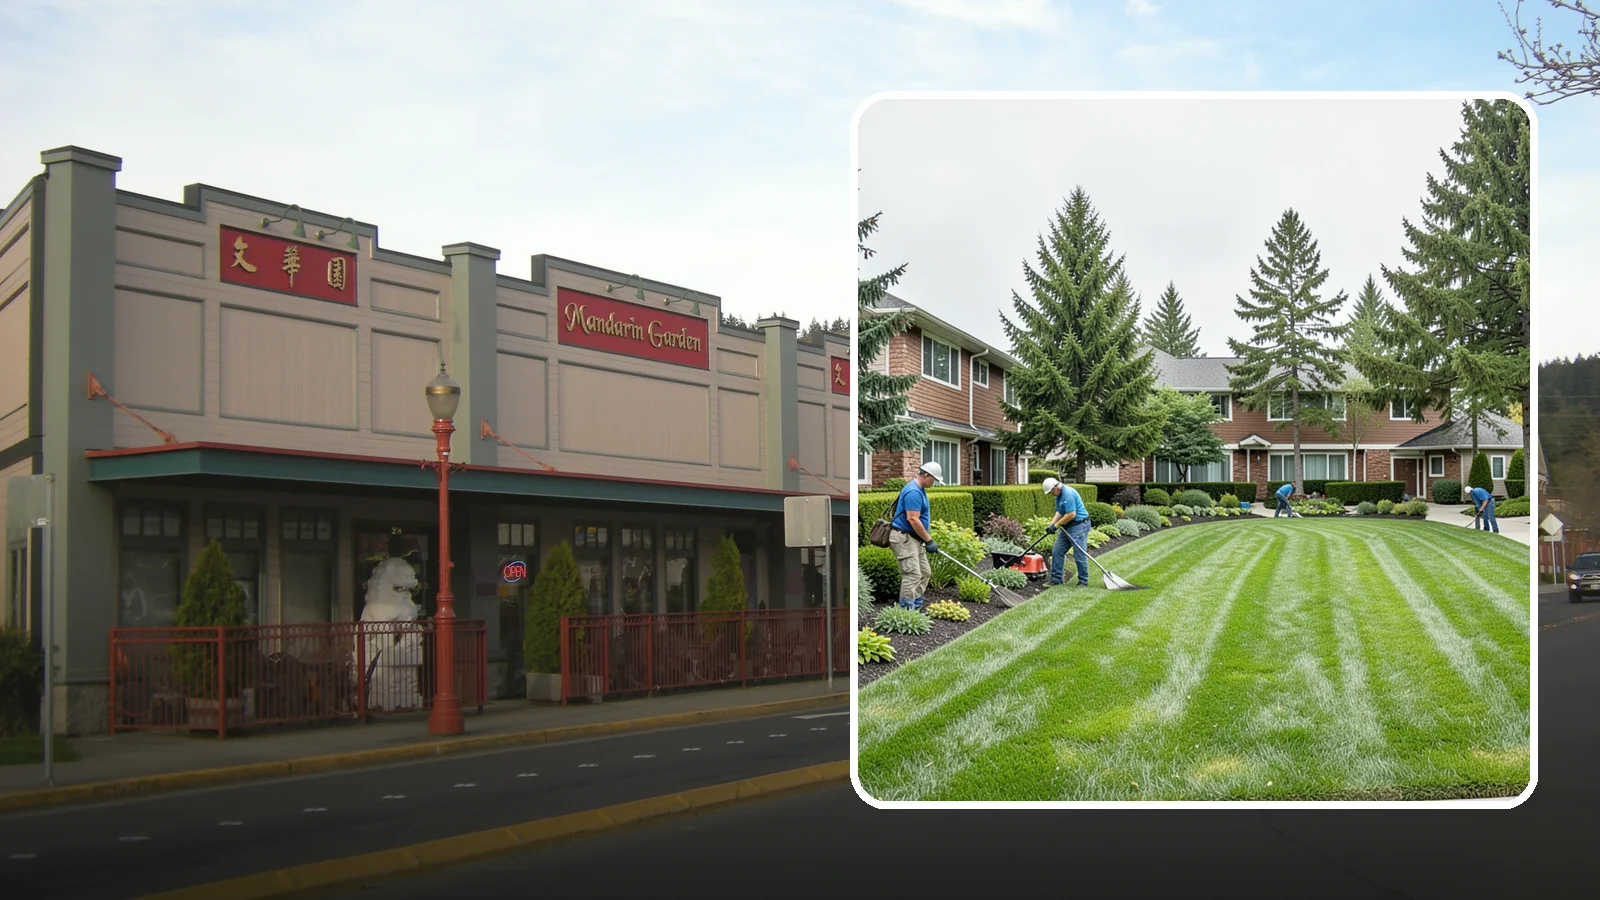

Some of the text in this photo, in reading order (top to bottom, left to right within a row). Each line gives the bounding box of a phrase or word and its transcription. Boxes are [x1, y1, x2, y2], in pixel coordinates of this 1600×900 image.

[231, 236, 346, 290] 文華園
[564, 302, 701, 351] Mandarin Garden
[504, 565, 526, 578] OPEN
